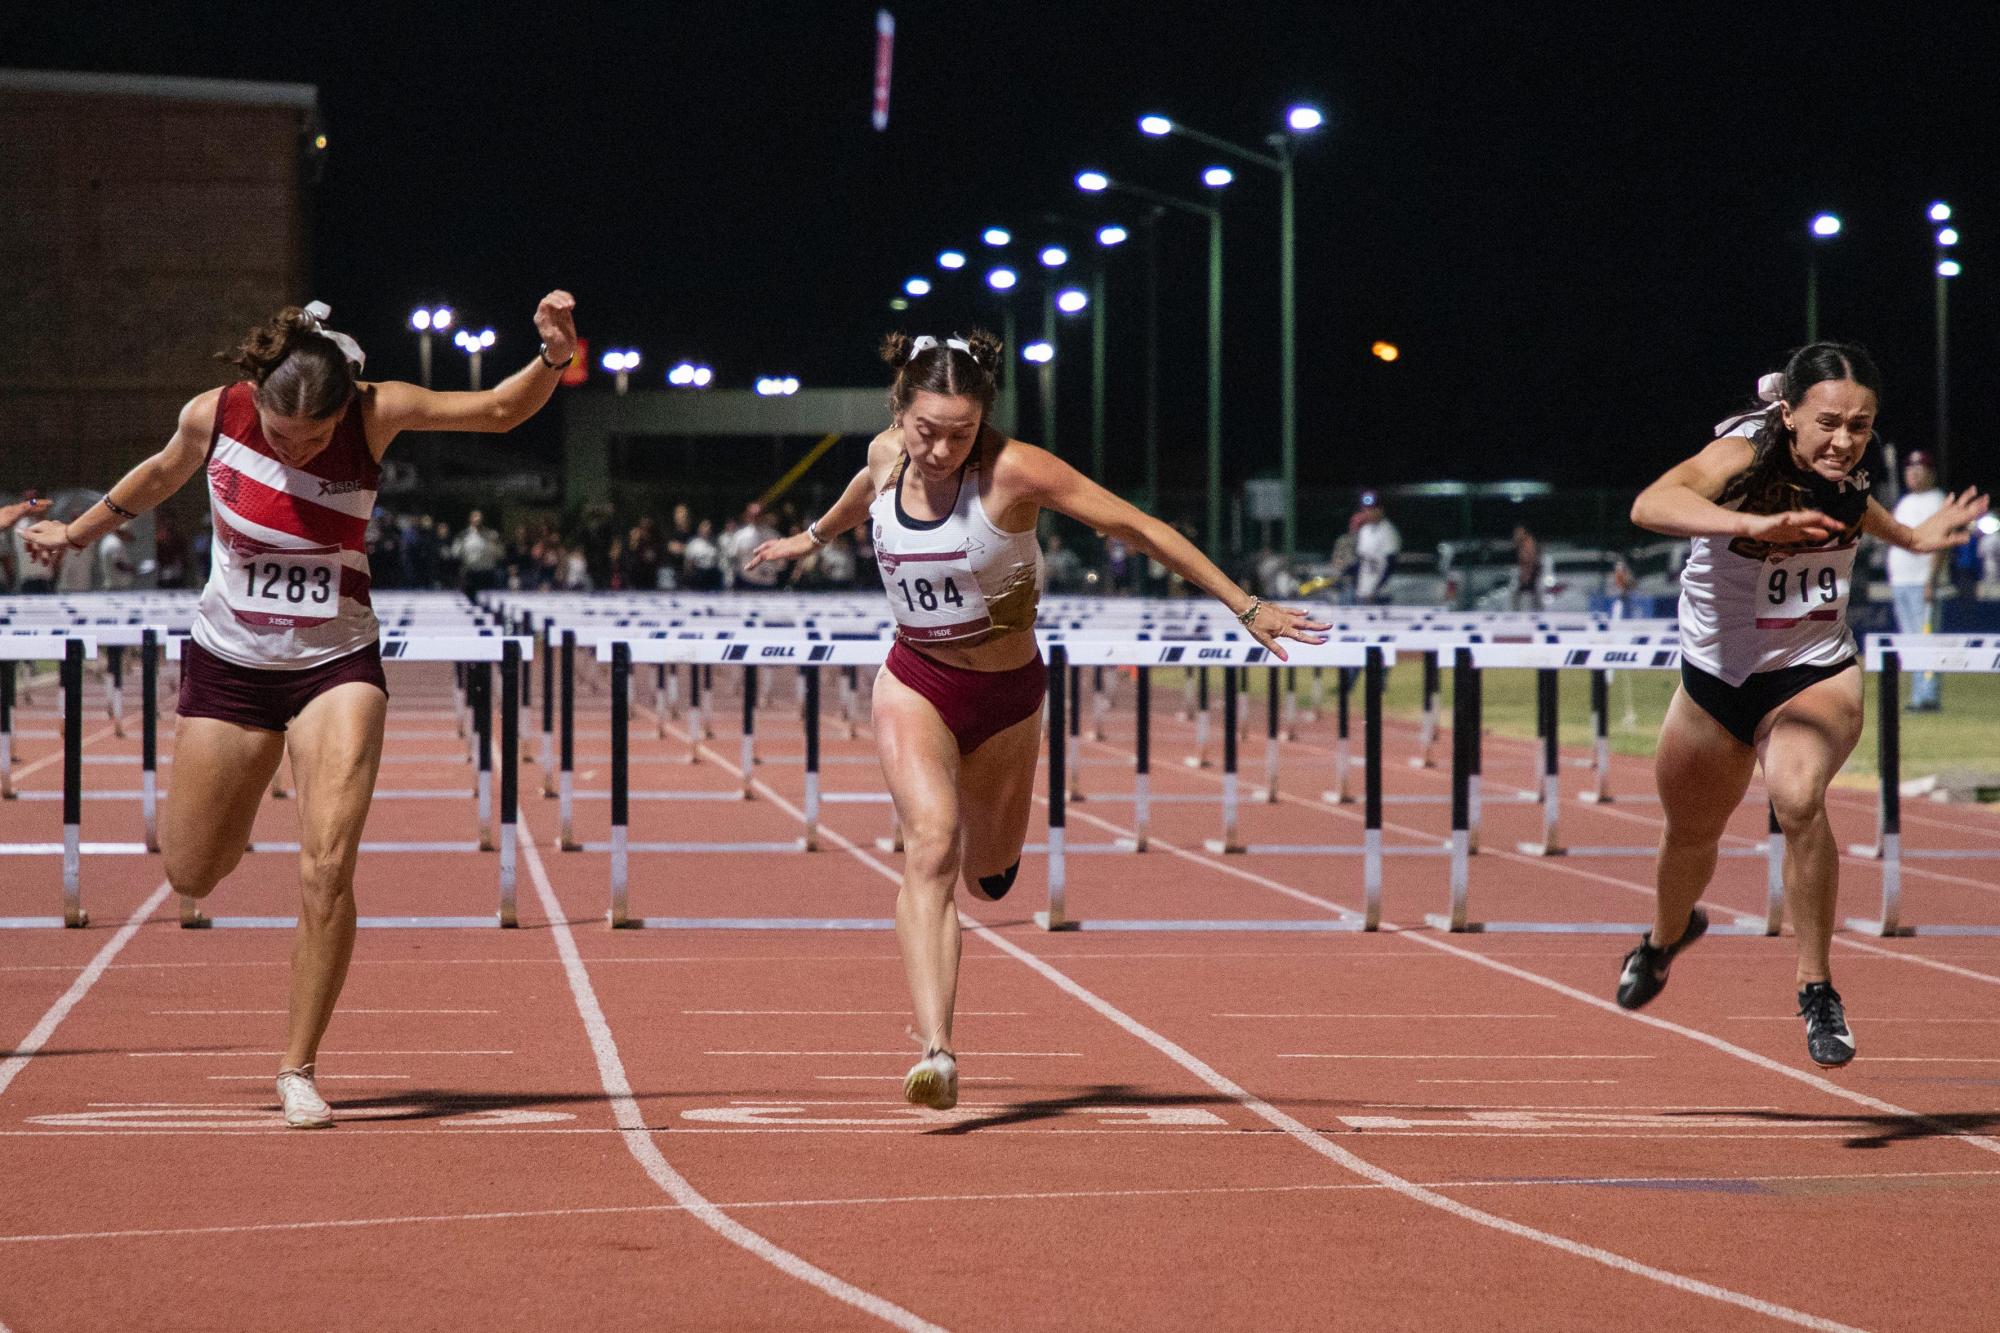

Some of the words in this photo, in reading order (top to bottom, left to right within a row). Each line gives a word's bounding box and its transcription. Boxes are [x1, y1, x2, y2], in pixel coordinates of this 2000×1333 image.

[243, 562, 331, 603] 1283
[897, 576, 964, 613] 184
[1768, 567, 1838, 605] 919
[761, 646, 796, 657] GILL
[1198, 647, 1232, 658] GILL
[1603, 650, 1638, 662] GILL
